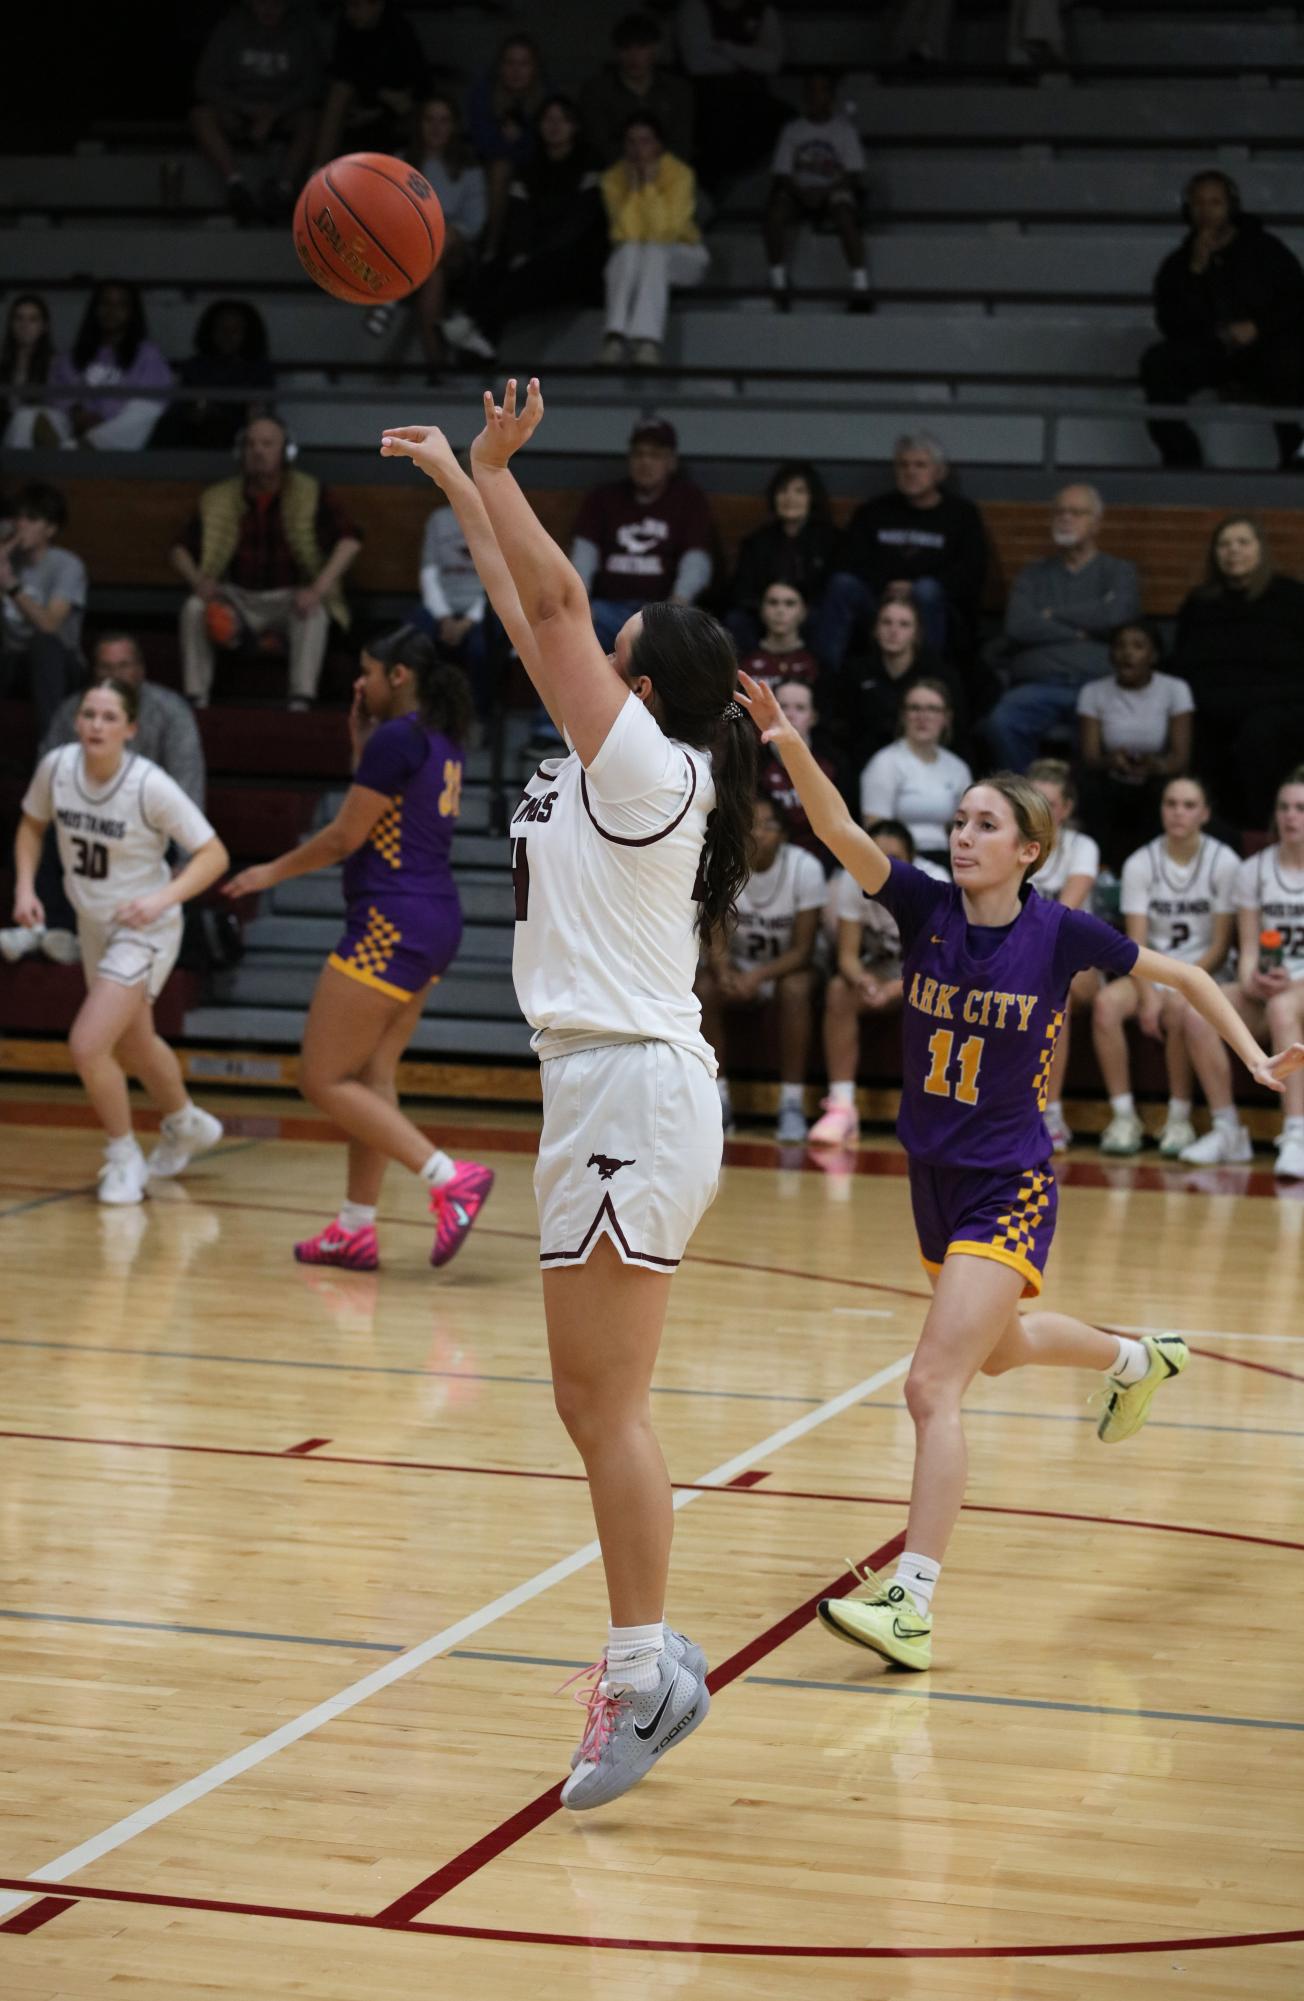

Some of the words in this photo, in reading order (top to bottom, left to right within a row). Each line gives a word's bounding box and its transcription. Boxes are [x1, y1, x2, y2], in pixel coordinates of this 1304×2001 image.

[71, 836, 110, 880] 30
[908, 972, 960, 1020] ARK
[963, 989, 1039, 1032] CITY
[923, 1028, 985, 1106] 11
